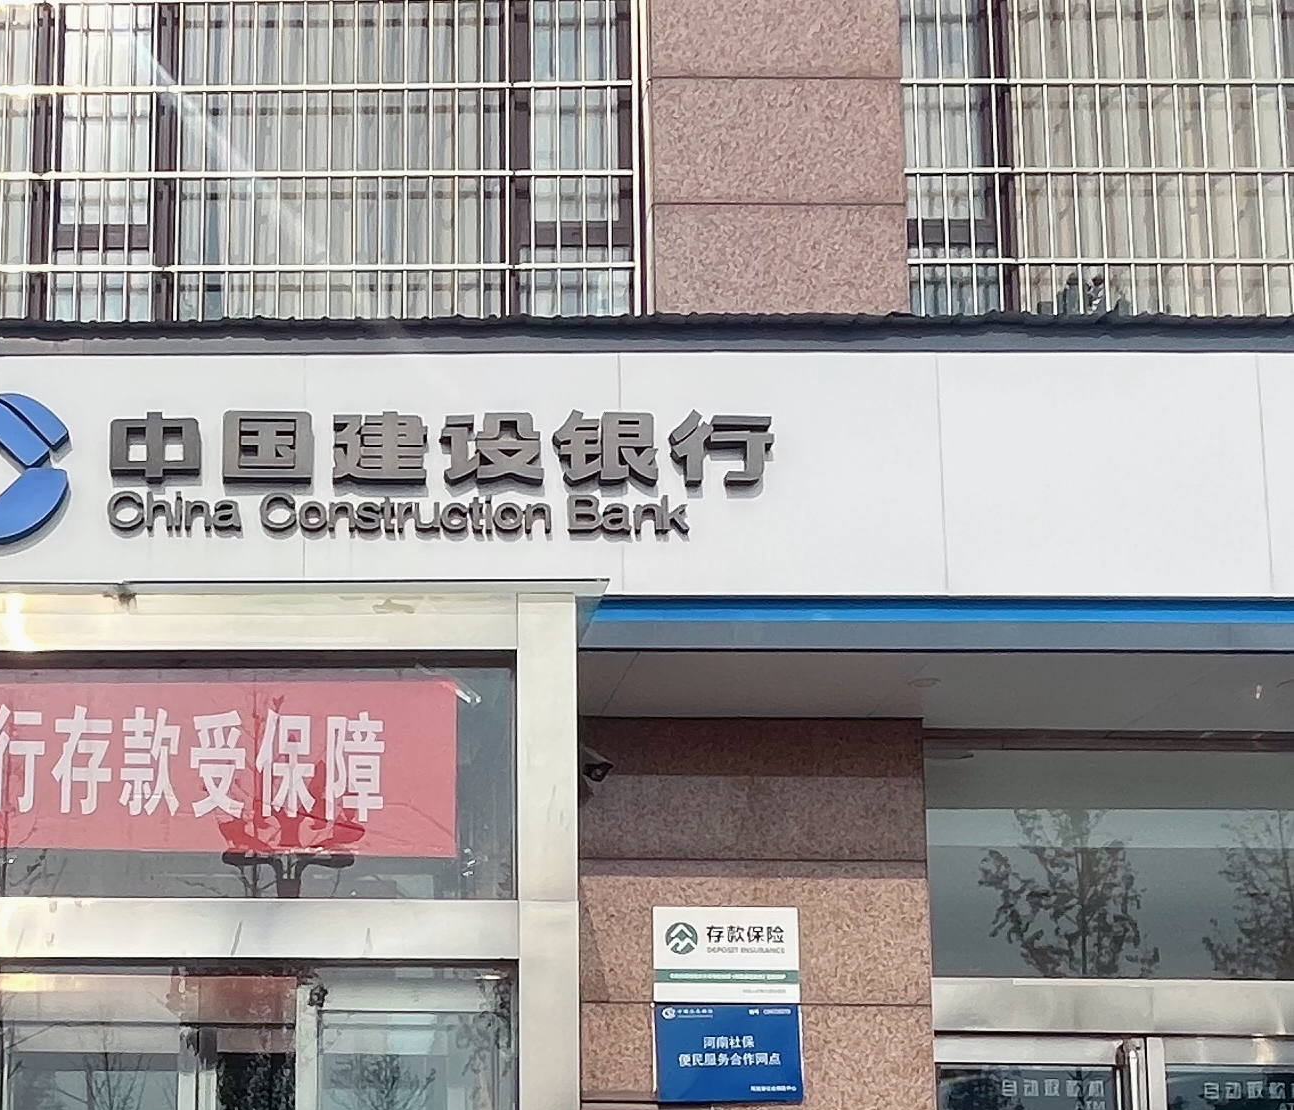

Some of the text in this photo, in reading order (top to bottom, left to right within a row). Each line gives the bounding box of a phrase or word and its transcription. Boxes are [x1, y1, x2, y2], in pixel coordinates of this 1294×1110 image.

[110, 410, 775, 487] 中国建设银行
[108, 491, 690, 534] China Construction Bank
[706, 925, 785, 943] 存款保险
